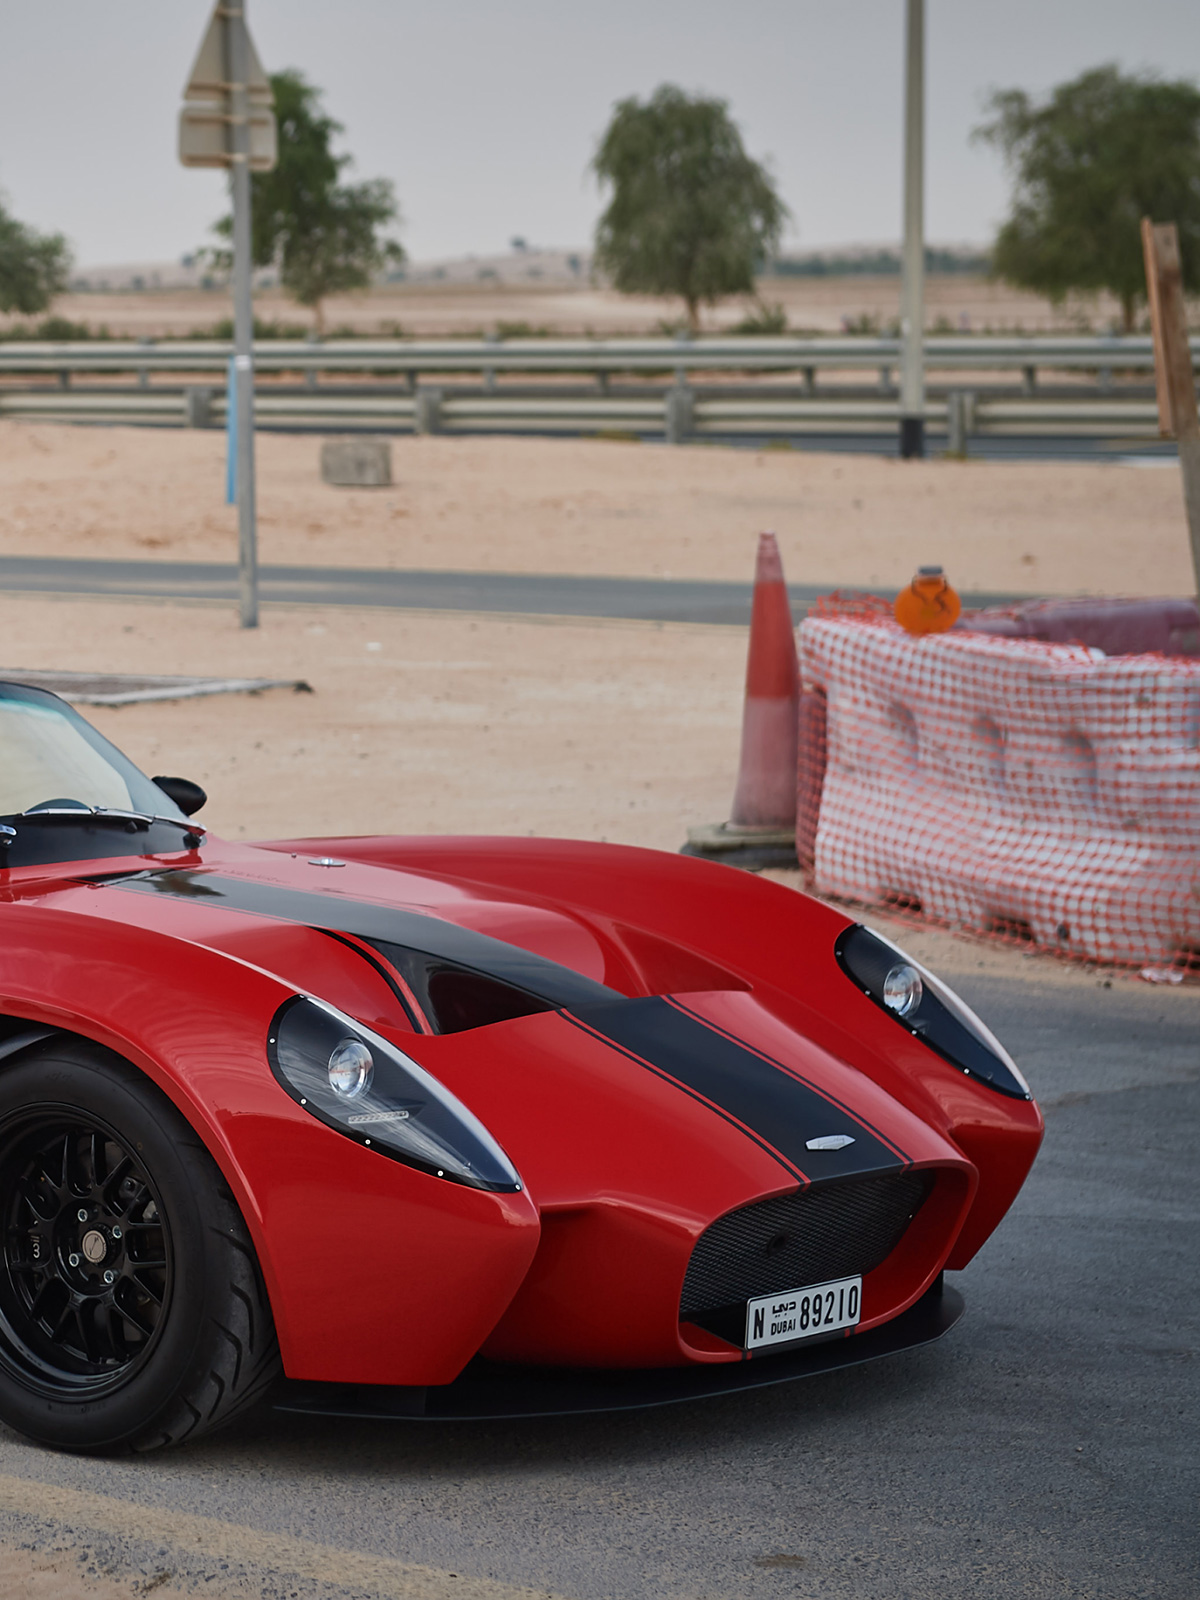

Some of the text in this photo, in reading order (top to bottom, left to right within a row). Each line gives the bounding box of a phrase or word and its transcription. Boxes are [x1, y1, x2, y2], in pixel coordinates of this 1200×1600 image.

[753, 1285, 858, 1340] N 89210
[772, 1301, 797, 1318] دبي
[770, 1319, 796, 1336] DUBAI
